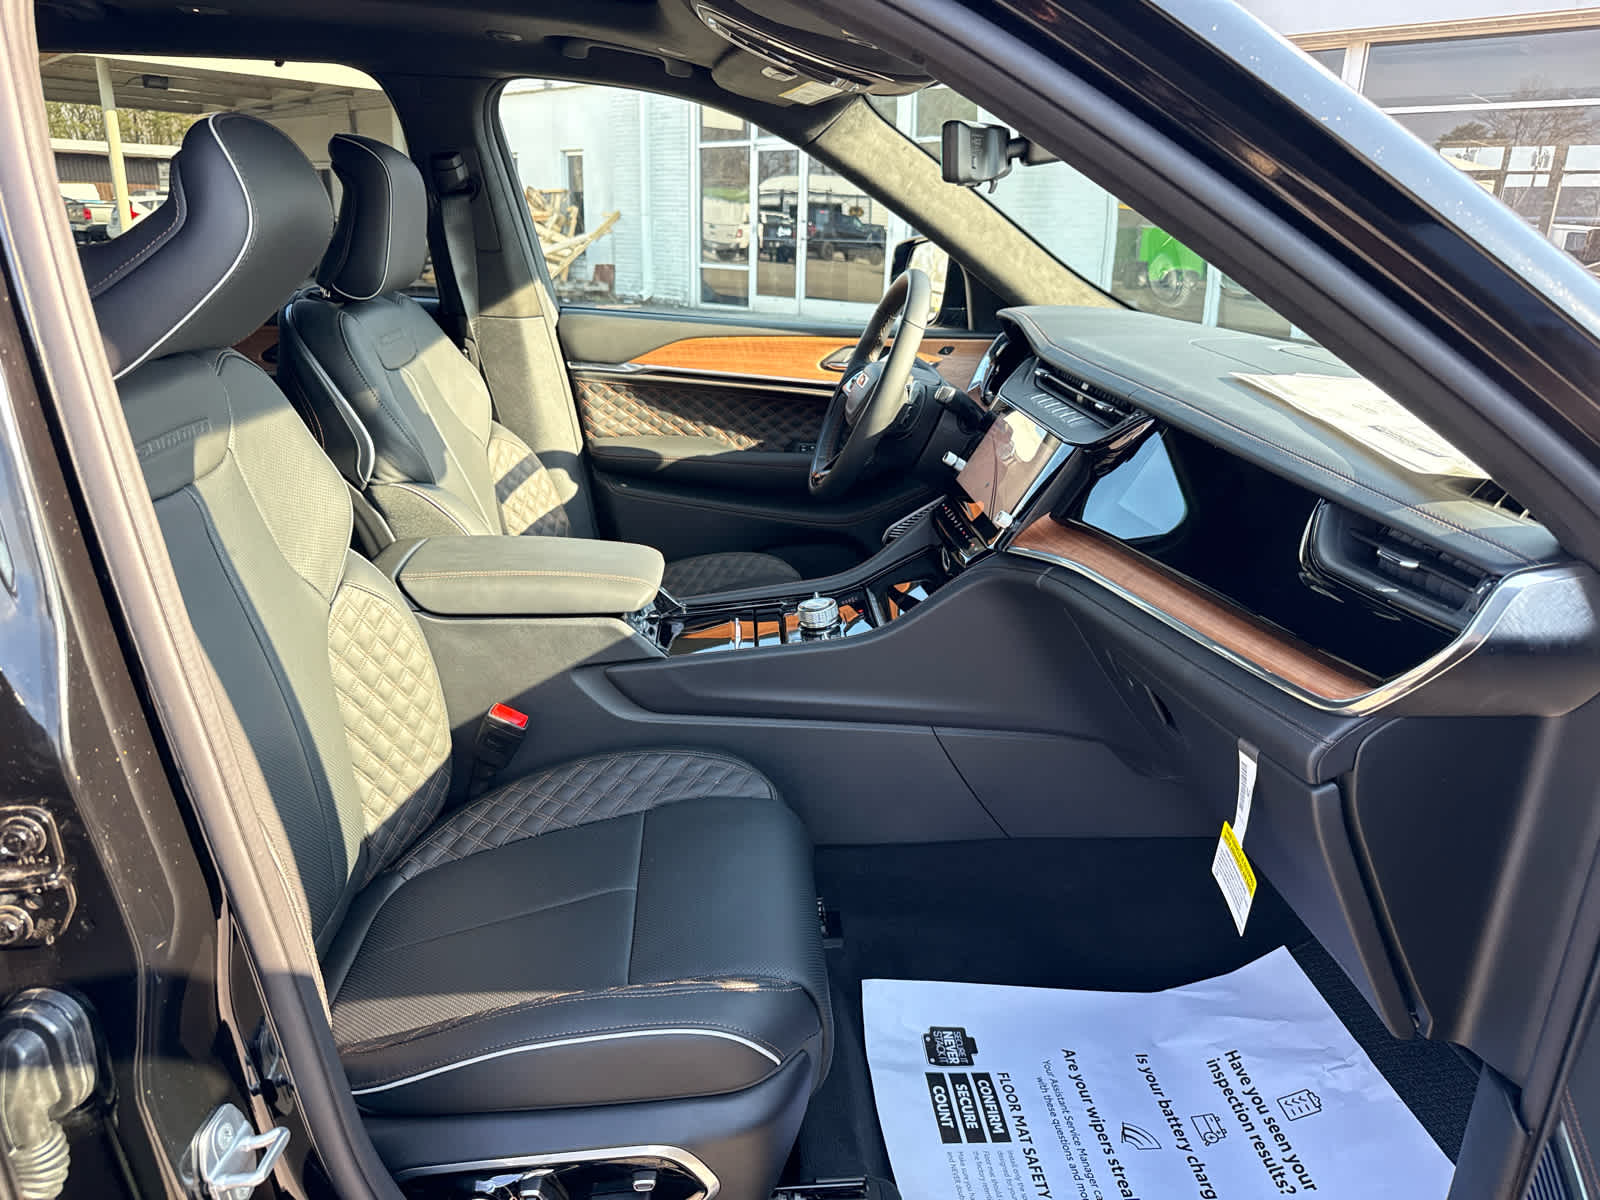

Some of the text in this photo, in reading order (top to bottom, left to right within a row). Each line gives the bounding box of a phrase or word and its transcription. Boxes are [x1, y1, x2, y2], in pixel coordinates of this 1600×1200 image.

[943, 1030, 960, 1064] NEVER
[1061, 1048, 1078, 1071] Are
[932, 1086, 954, 1128] COUNT
[955, 1083, 979, 1129] SECURE
[977, 1079, 1005, 1134] CONFIRM
[1068, 1073, 1093, 1104] your
[997, 1072, 1053, 1199] FLOOR MAT SAFETY
[1042, 1059, 1055, 1078] Your
[1049, 1078, 1070, 1114] Assistant
[1064, 1115, 1081, 1146] Service
[1076, 1147, 1098, 1188] Manager
[1043, 1094, 1057, 1118] these
[1052, 1118, 1074, 1161] questions
[1069, 1163, 1084, 1181] and
[1086, 1106, 1115, 1155] wipers
[1135, 1054, 1218, 1200] Is your battery charg
[1206, 1057, 1297, 1195] inspection results?
[1224, 1049, 1317, 1191] Have you seen your
